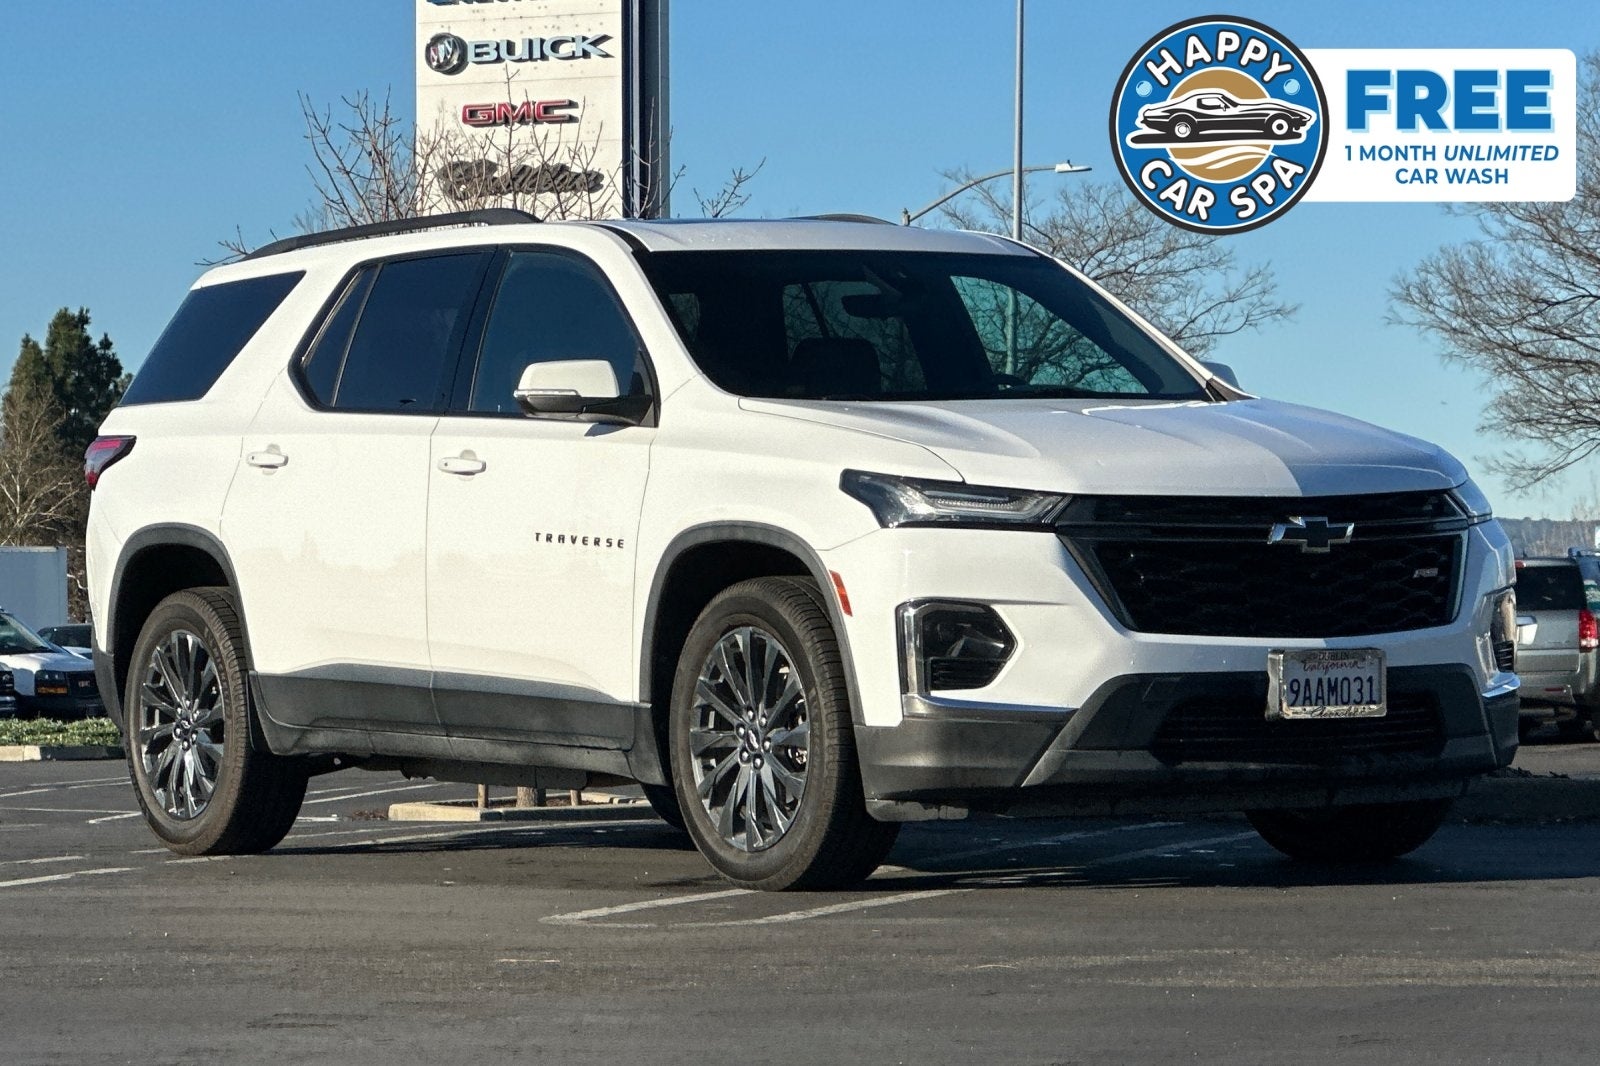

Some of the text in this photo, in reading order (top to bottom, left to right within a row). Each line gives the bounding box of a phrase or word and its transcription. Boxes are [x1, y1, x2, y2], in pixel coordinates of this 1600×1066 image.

[467, 34, 612, 63] BUICK
[462, 99, 574, 125] GMC
[535, 532, 624, 549] TRAVERSE
[1289, 675, 1377, 706] 9AAM031
